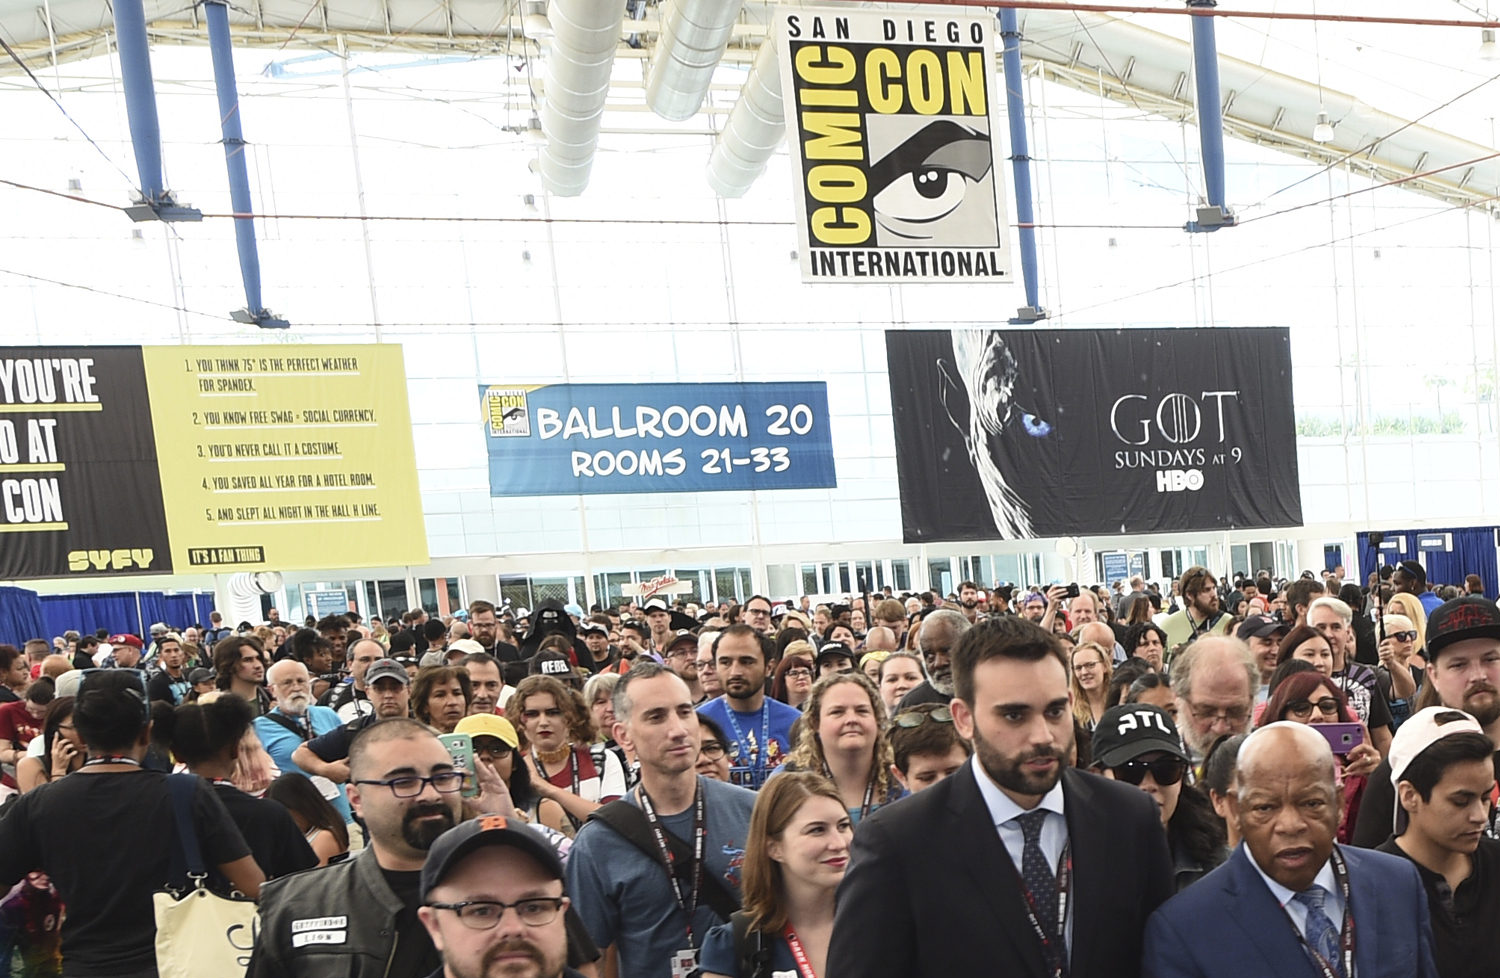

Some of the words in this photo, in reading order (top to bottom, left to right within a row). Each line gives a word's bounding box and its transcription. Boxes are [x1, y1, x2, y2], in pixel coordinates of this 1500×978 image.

[787, 15, 850, 39] SAN
[882, 20, 984, 44] DIEGO
[795, 45, 872, 245] COMIC
[865, 48, 987, 116] CON
[810, 250, 1005, 277] INTERNATIONAL
[196, 358, 213, 372] YOU
[215, 358, 240, 372] THINK
[259, 357, 267, 371] IS
[269, 357, 285, 371] THE
[287, 357, 319, 371] PERFECT
[321, 356, 358, 371] WEATHER
[0, 358, 99, 404] YOU'RE
[199, 378, 215, 392] FOR
[218, 378, 256, 392] SPANDEX.
[501, 396, 524, 408] CON
[204, 411, 220, 425] YOU
[223, 411, 247, 424] KNOW
[250, 410, 268, 424] FREE
[271, 410, 294, 423] SWAG
[303, 409, 331, 423] SOCIAL
[333, 408, 377, 422] CURRENCY.
[536, 404, 749, 440] BALLROOM
[765, 403, 814, 437] 20
[1110, 390, 1241, 446] GOT
[0, 419, 19, 464] O
[28, 418, 58, 464] AT
[208, 443, 232, 458] YOU'D
[236, 443, 260, 457] NEVER
[263, 442, 281, 457] CALL
[284, 442, 292, 456] IT
[294, 442, 300, 455] A
[302, 441, 342, 456] COSTUME.
[570, 446, 687, 478] ROOMS
[700, 446, 791, 475] 21-33
[1114, 448, 1206, 469] SUNDAYS
[1212, 453, 1226, 465] AT
[1230, 448, 1242, 465] 9
[212, 476, 229, 490] YOU
[232, 475, 257, 489] SAVED
[260, 475, 273, 488] ALL
[275, 474, 295, 488] YEAR
[298, 474, 313, 488] FOR
[316, 474, 321, 487] A
[323, 473, 348, 487] HOTEL
[350, 472, 376, 486] ROOM.
[1156, 469, 1204, 493] HBO
[4, 477, 64, 523] CON
[218, 507, 234, 521] AND
[236, 506, 260, 520] SLEPT
[263, 506, 277, 520] ALL
[279, 505, 302, 519] NIGHT
[304, 505, 313, 518] IN
[315, 504, 330, 518] THE
[332, 504, 350, 517] HALL
[353, 503, 359, 517] H
[361, 503, 381, 517] LINE.
[68, 548, 154, 571] SYFY
[192, 549, 209, 564] IT'S
[211, 549, 217, 563] A
[218, 548, 234, 563] FAN
[235, 547, 261, 563] THING
[1117, 710, 1171, 736] ATL
